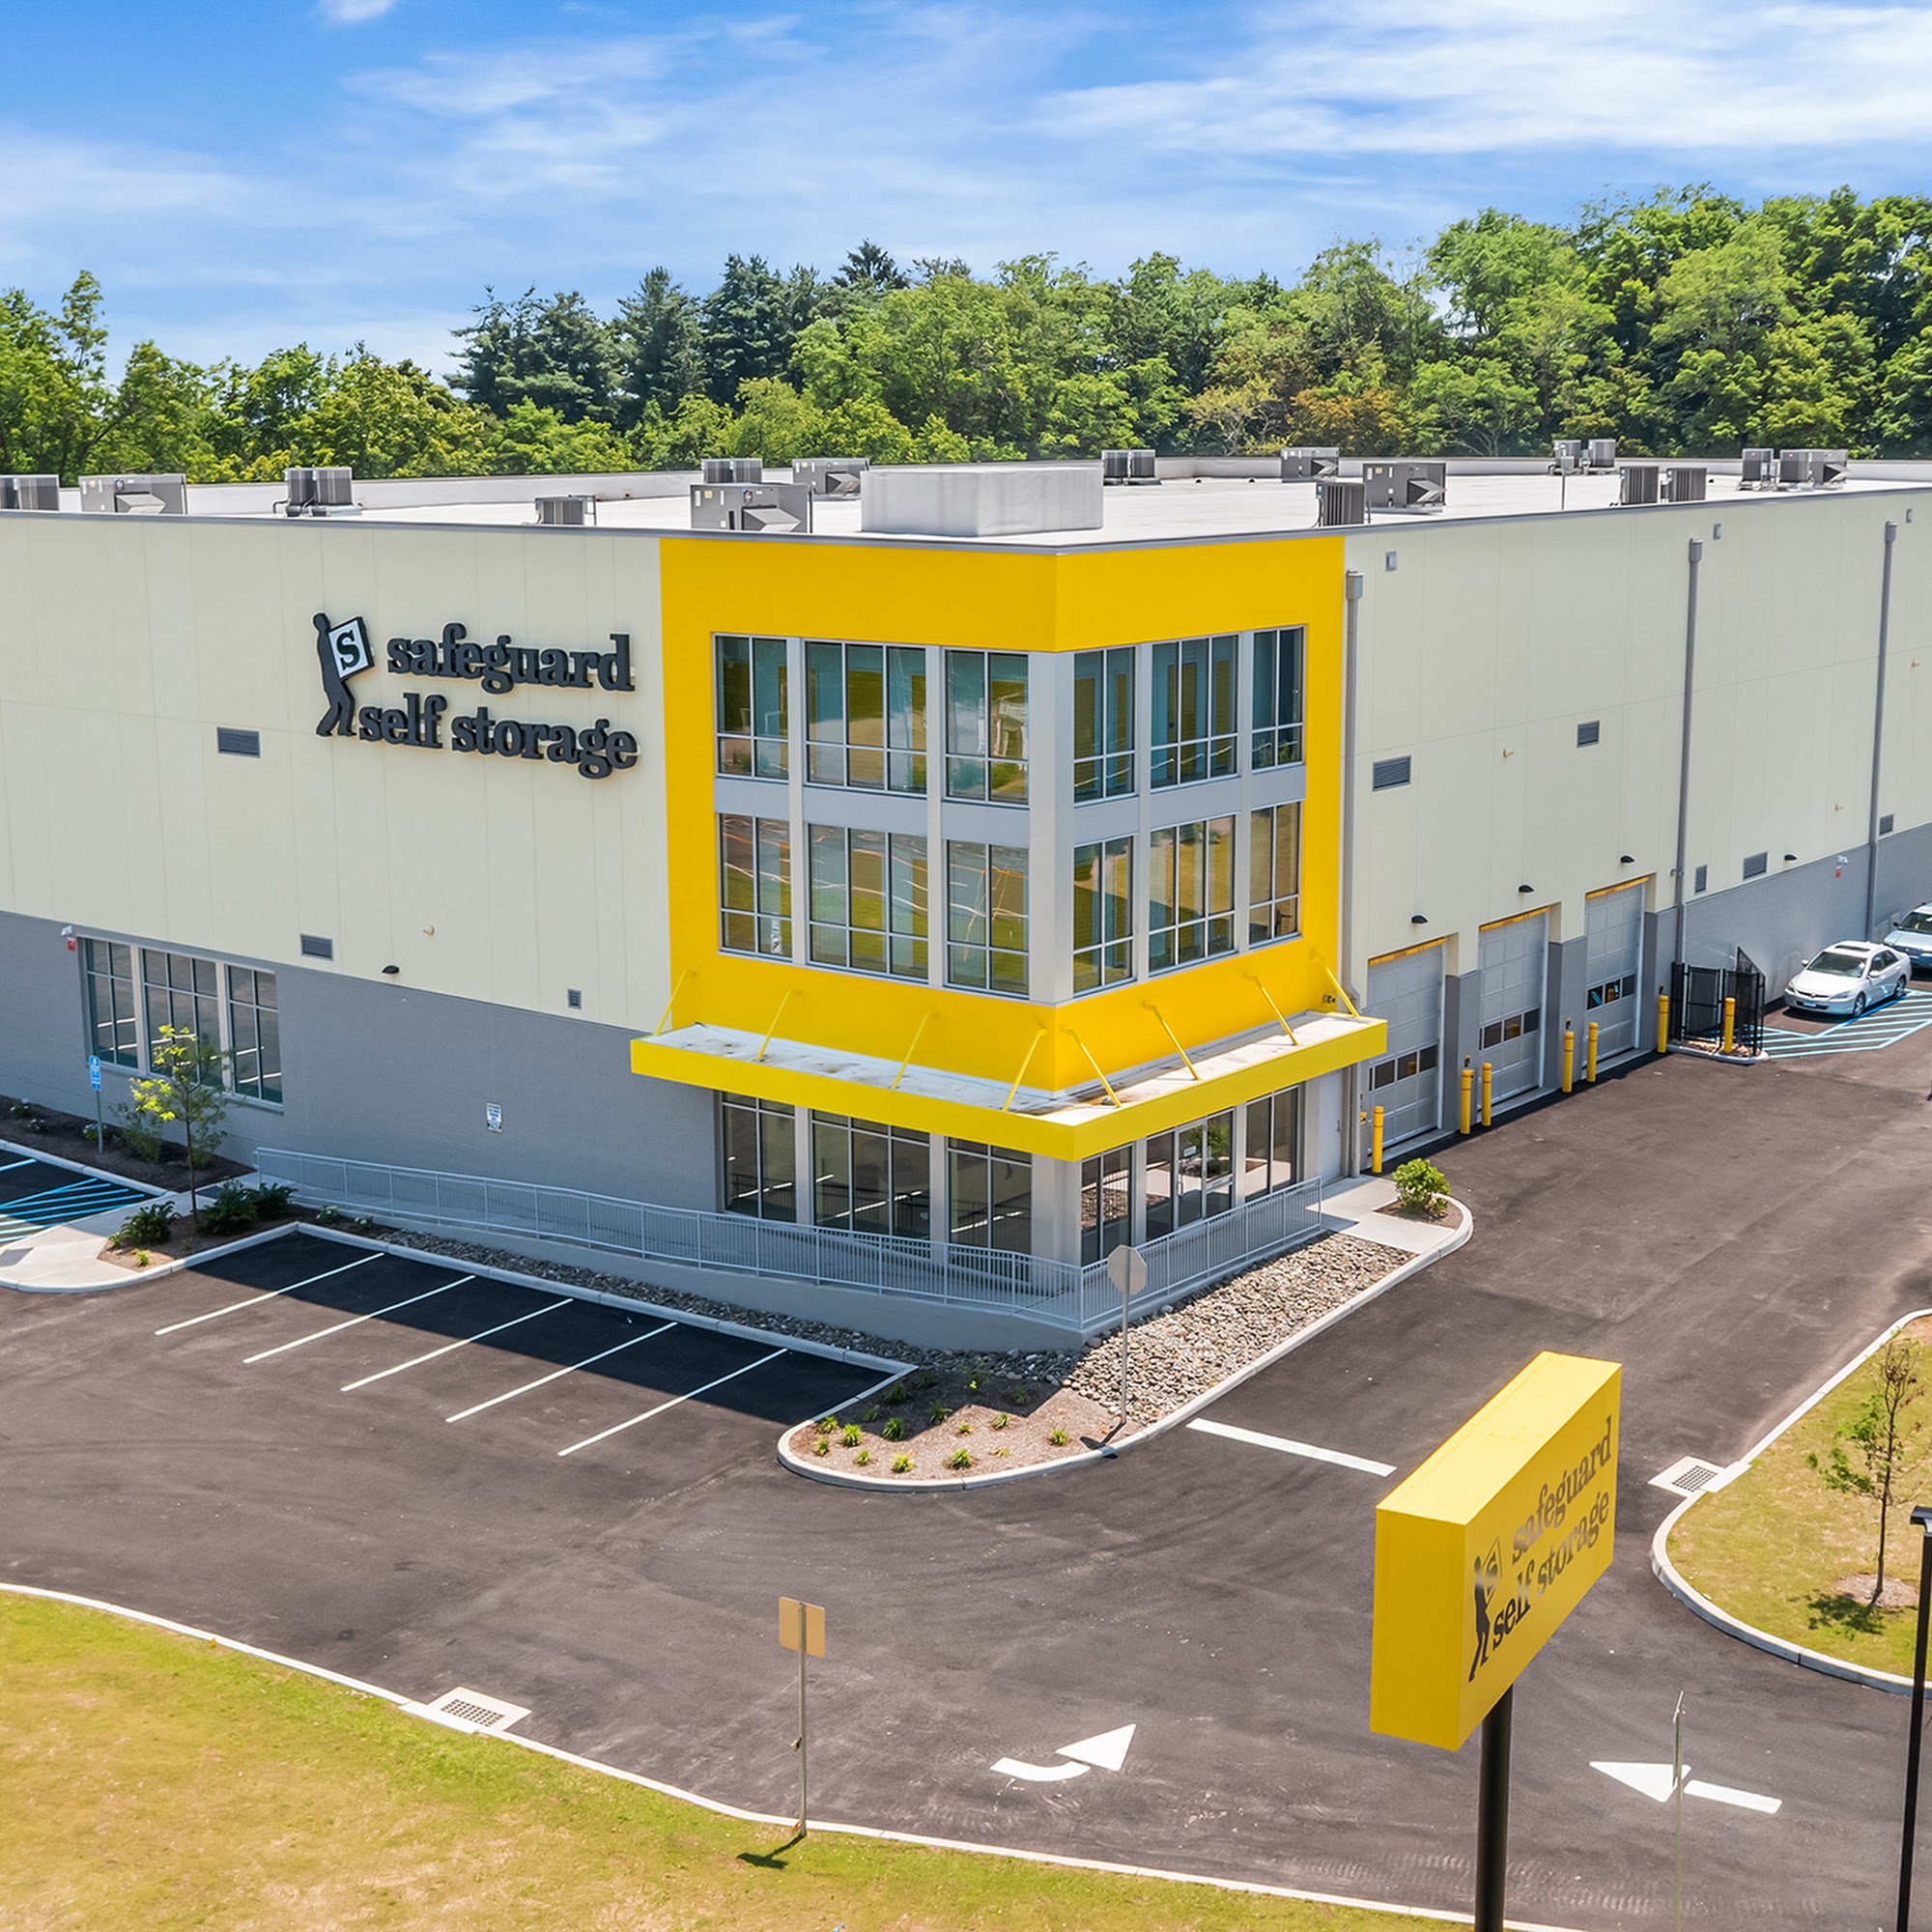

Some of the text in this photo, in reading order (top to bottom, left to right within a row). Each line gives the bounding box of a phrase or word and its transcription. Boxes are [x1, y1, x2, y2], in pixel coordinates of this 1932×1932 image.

[335, 629, 360, 671] S
[386, 622, 635, 695] safeguard
[358, 693, 639, 780] self storage
[1512, 1415, 1612, 1564] safeguard
[1492, 1491, 1610, 1651] self storage
